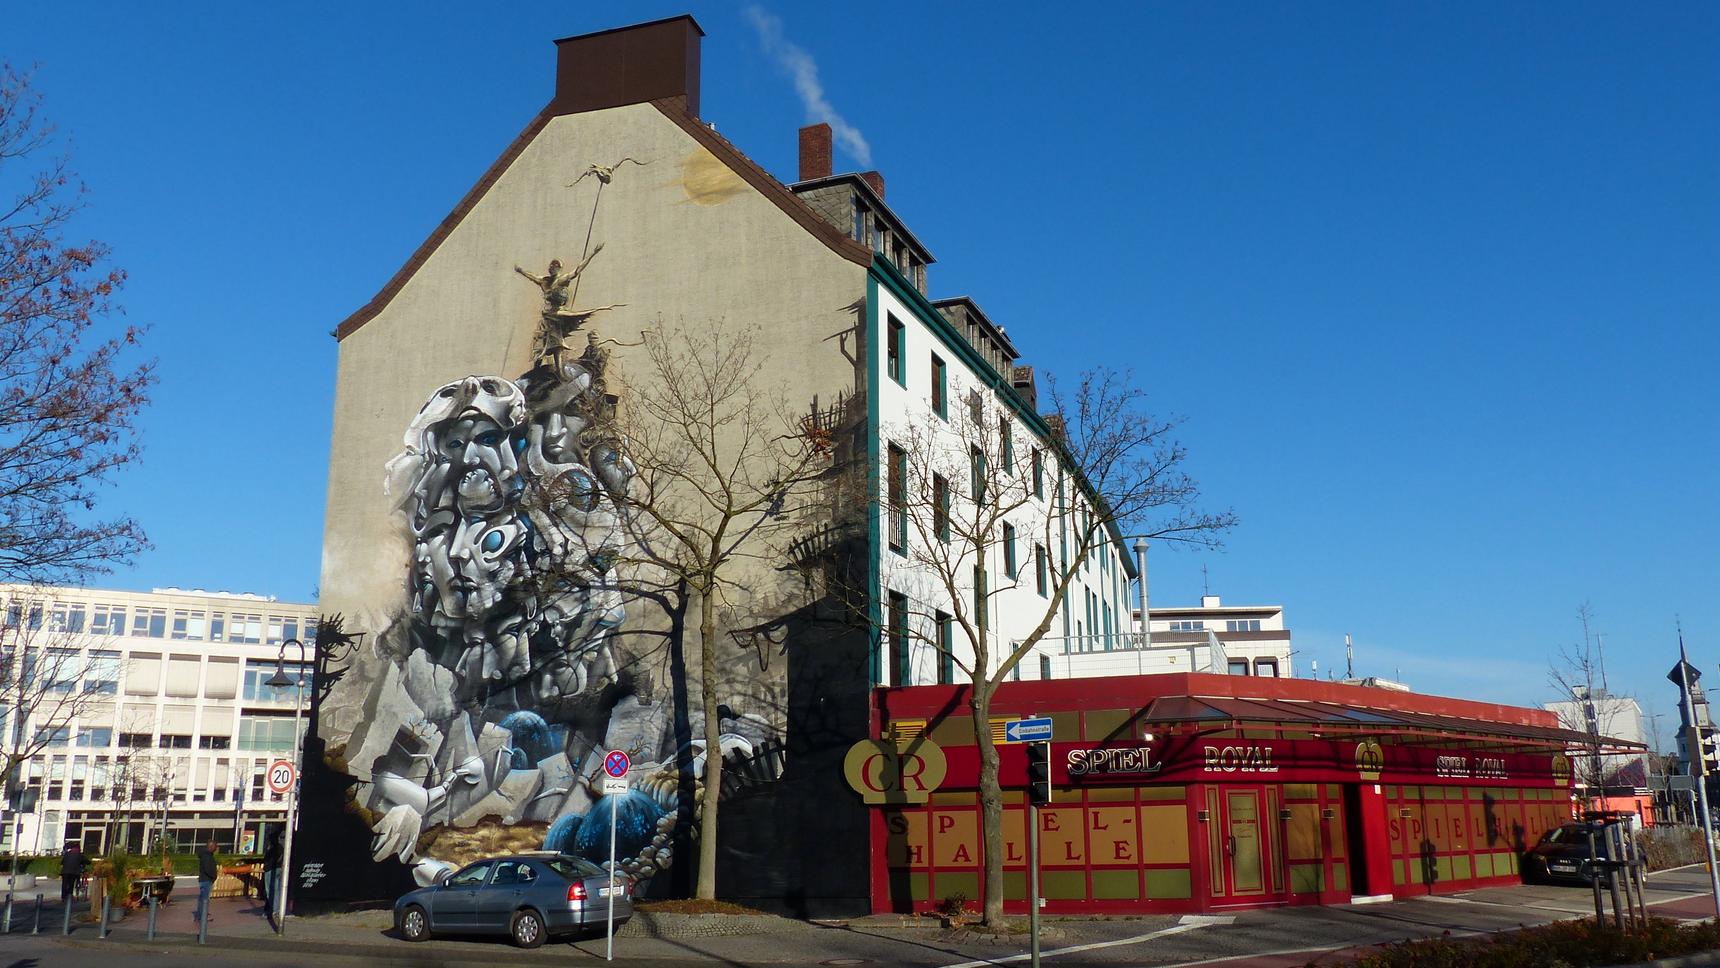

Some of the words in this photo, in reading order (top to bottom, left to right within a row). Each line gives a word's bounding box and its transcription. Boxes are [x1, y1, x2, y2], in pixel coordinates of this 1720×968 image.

[862, 753, 928, 792] CR
[1067, 748, 1162, 774] SPIEL
[1204, 746, 1279, 772] ROYAL
[274, 769, 290, 784] 20
